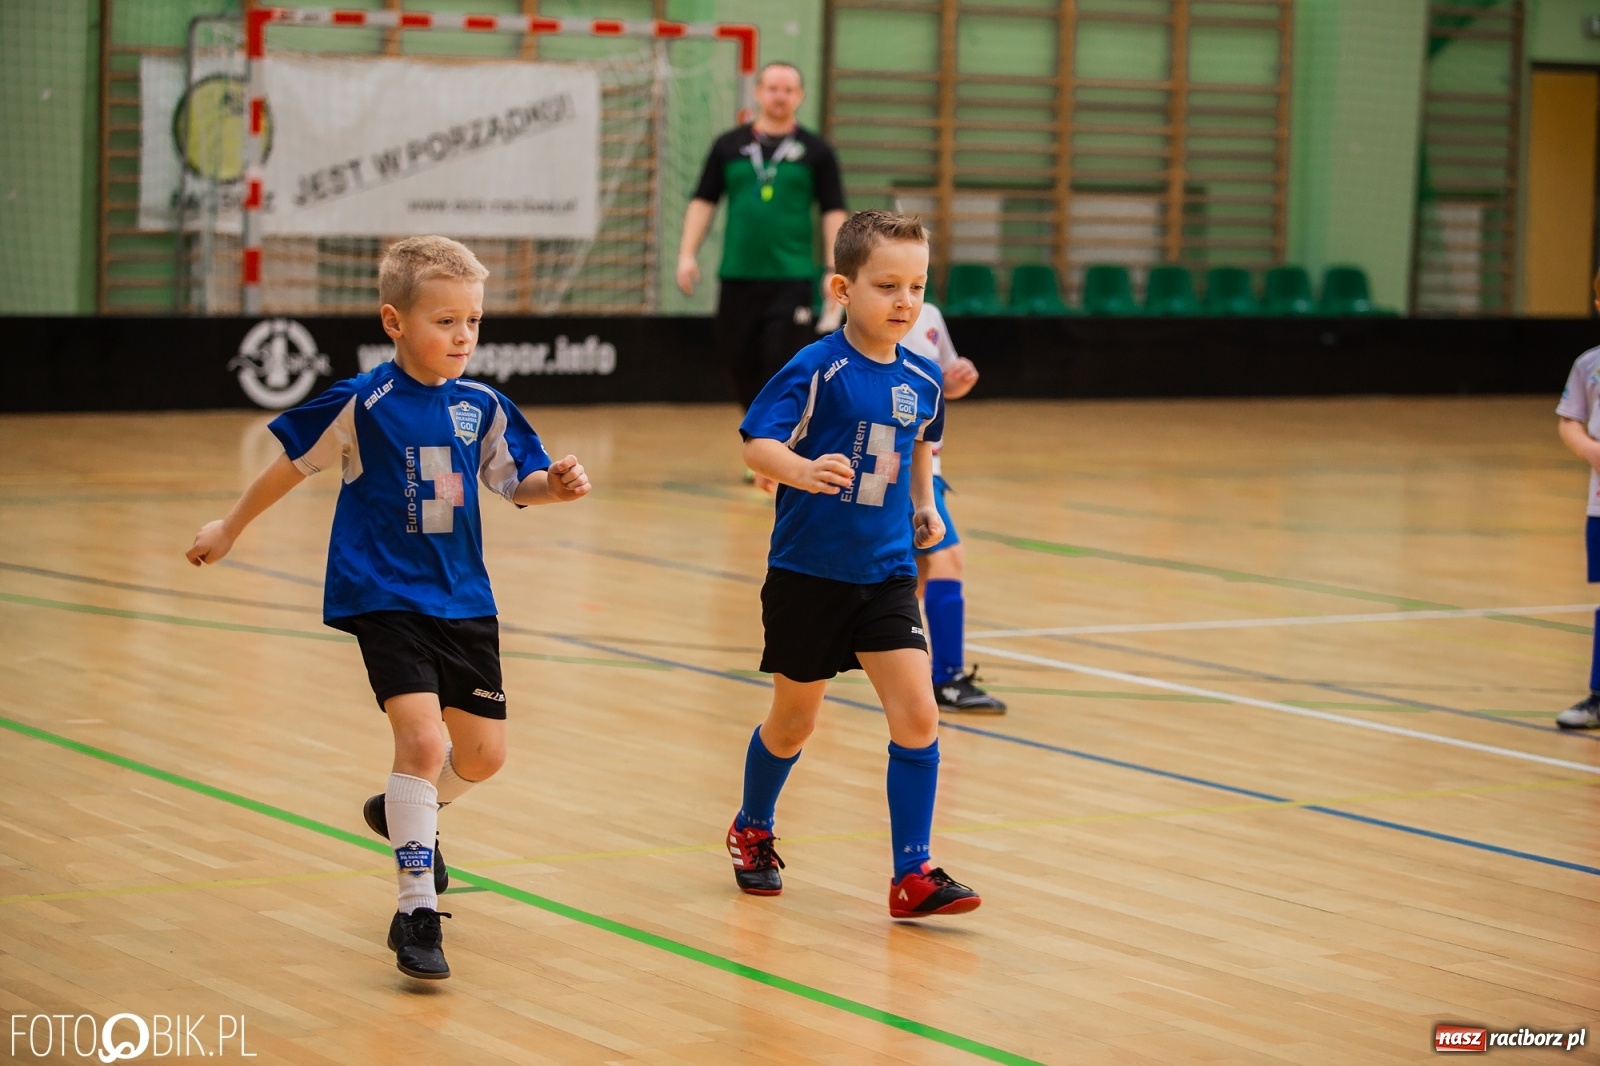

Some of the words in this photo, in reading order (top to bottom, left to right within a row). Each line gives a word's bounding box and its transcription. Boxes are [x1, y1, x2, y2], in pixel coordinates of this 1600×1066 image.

[294, 156, 363, 208] JEST
[371, 147, 401, 181] W
[898, 404, 913, 414] GOL
[460, 421, 475, 432] GOL
[404, 446, 419, 534] Euro-System
[404, 859, 427, 867] GOL
